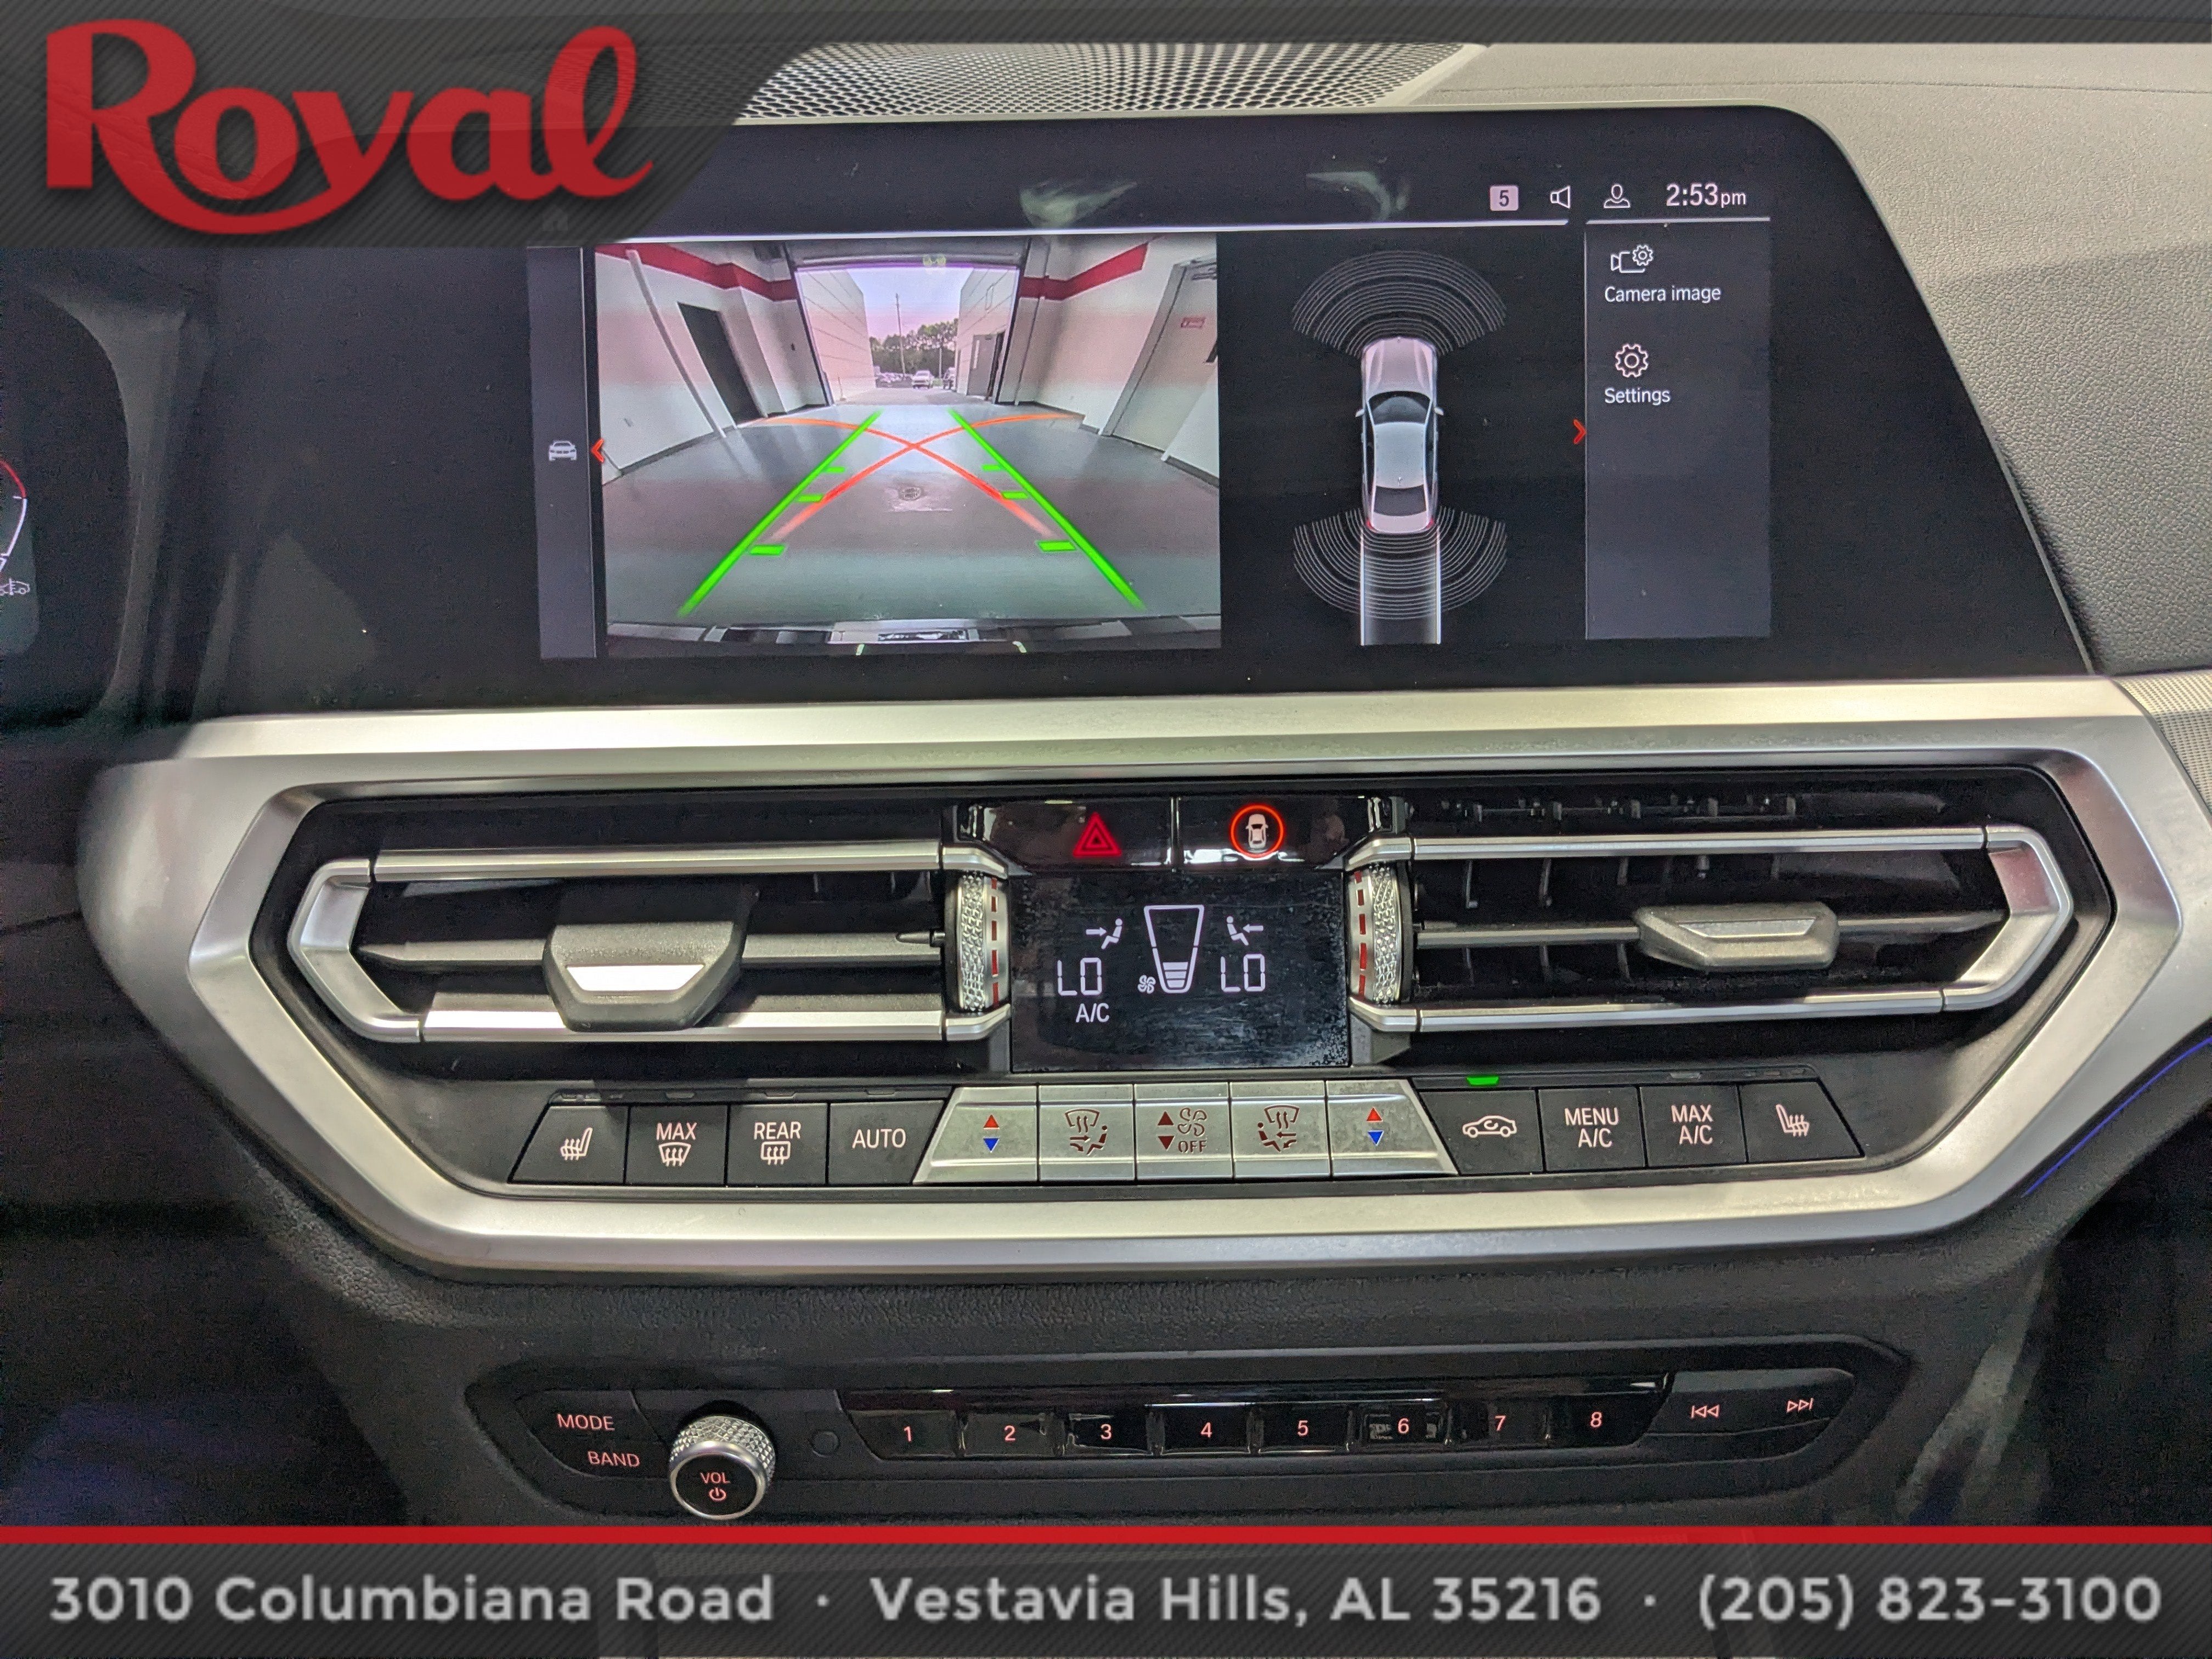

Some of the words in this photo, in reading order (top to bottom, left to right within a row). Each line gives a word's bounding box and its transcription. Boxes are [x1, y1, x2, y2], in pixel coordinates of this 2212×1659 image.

[1499, 190, 1509, 207] 5
[1666, 183, 1747, 208] 2:53pm
[1605, 286, 1667, 303] Camera
[1672, 285, 1721, 303] image
[1605, 387, 1671, 405] Settings
[1076, 1002, 1109, 1023] A/C
[1565, 1107, 1619, 1126] MENU
[1671, 1104, 1713, 1123] MAX
[656, 1122, 697, 1141] MAX
[754, 1121, 801, 1140] REAR
[852, 1128, 906, 1149] AUTO
[1578, 1128, 1613, 1148] A/C
[1679, 1125, 1713, 1144] A/C
[1178, 1140, 1207, 1153] OFF
[557, 1413, 616, 1431] MODE
[1297, 1420, 1308, 1437] 5
[1397, 1417, 1410, 1434] 6
[1495, 1414, 1506, 1431] 7
[1590, 1411, 1602, 1428] 8
[904, 1426, 913, 1442] 1
[1005, 1425, 1016, 1442] 2
[1101, 1424, 1113, 1440] 3
[1200, 1422, 1212, 1438] 4
[587, 1450, 640, 1468] BAND
[700, 1472, 731, 1485] VOL
